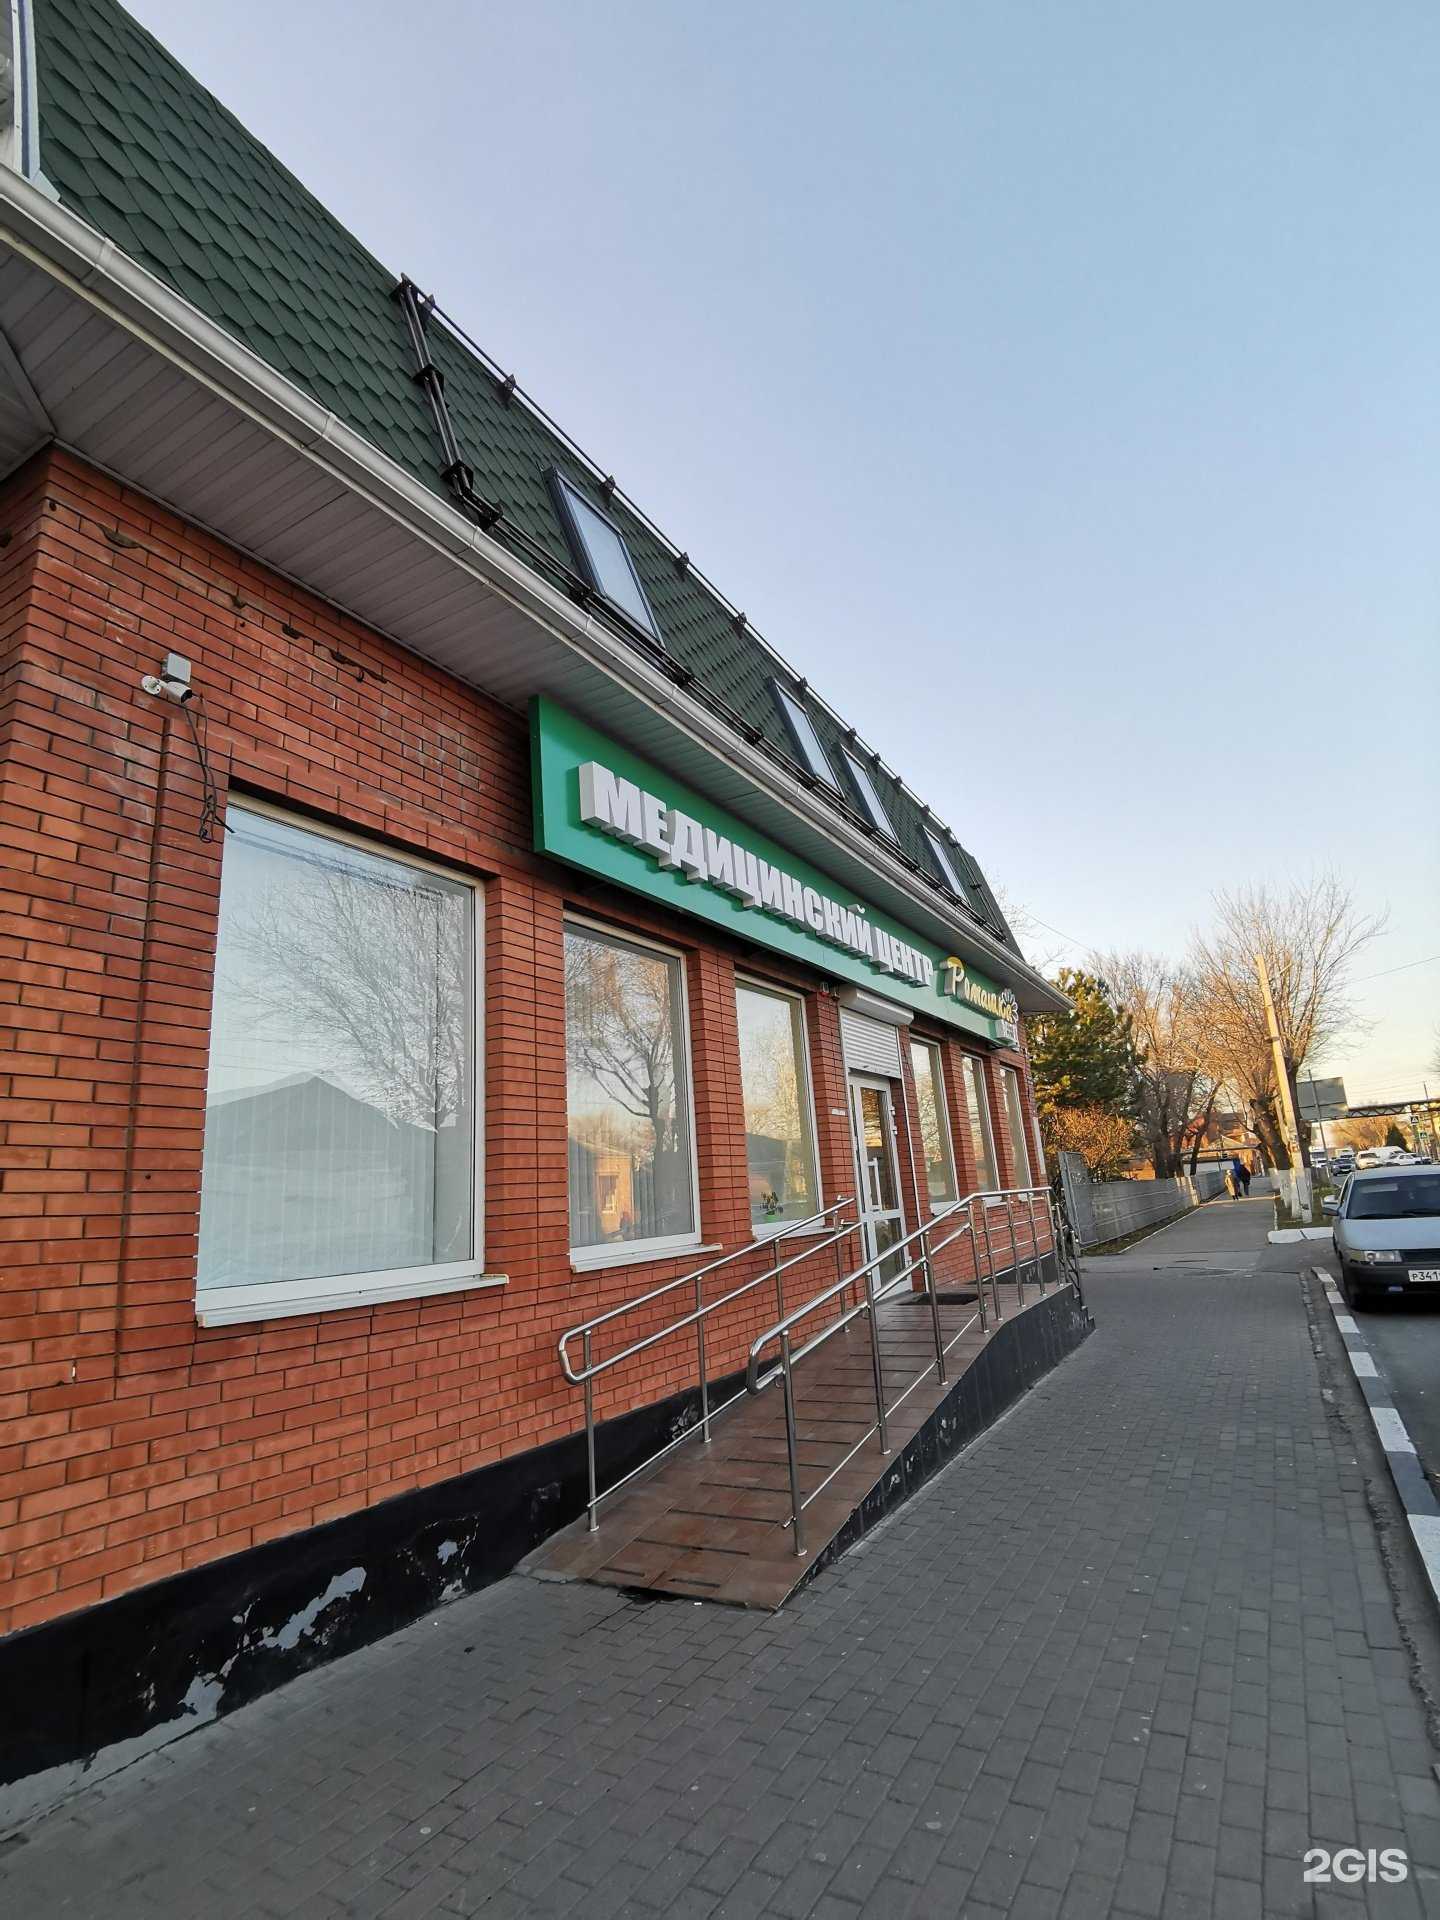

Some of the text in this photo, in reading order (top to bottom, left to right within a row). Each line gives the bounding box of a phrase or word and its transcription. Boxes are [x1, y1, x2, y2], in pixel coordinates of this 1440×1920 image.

[579, 761, 934, 987] МЕДИЦИНСКИЙ ЦЕНТР
[941, 956, 1013, 1024] Ромашка
[1412, 1271, 1440, 1280] Р341
